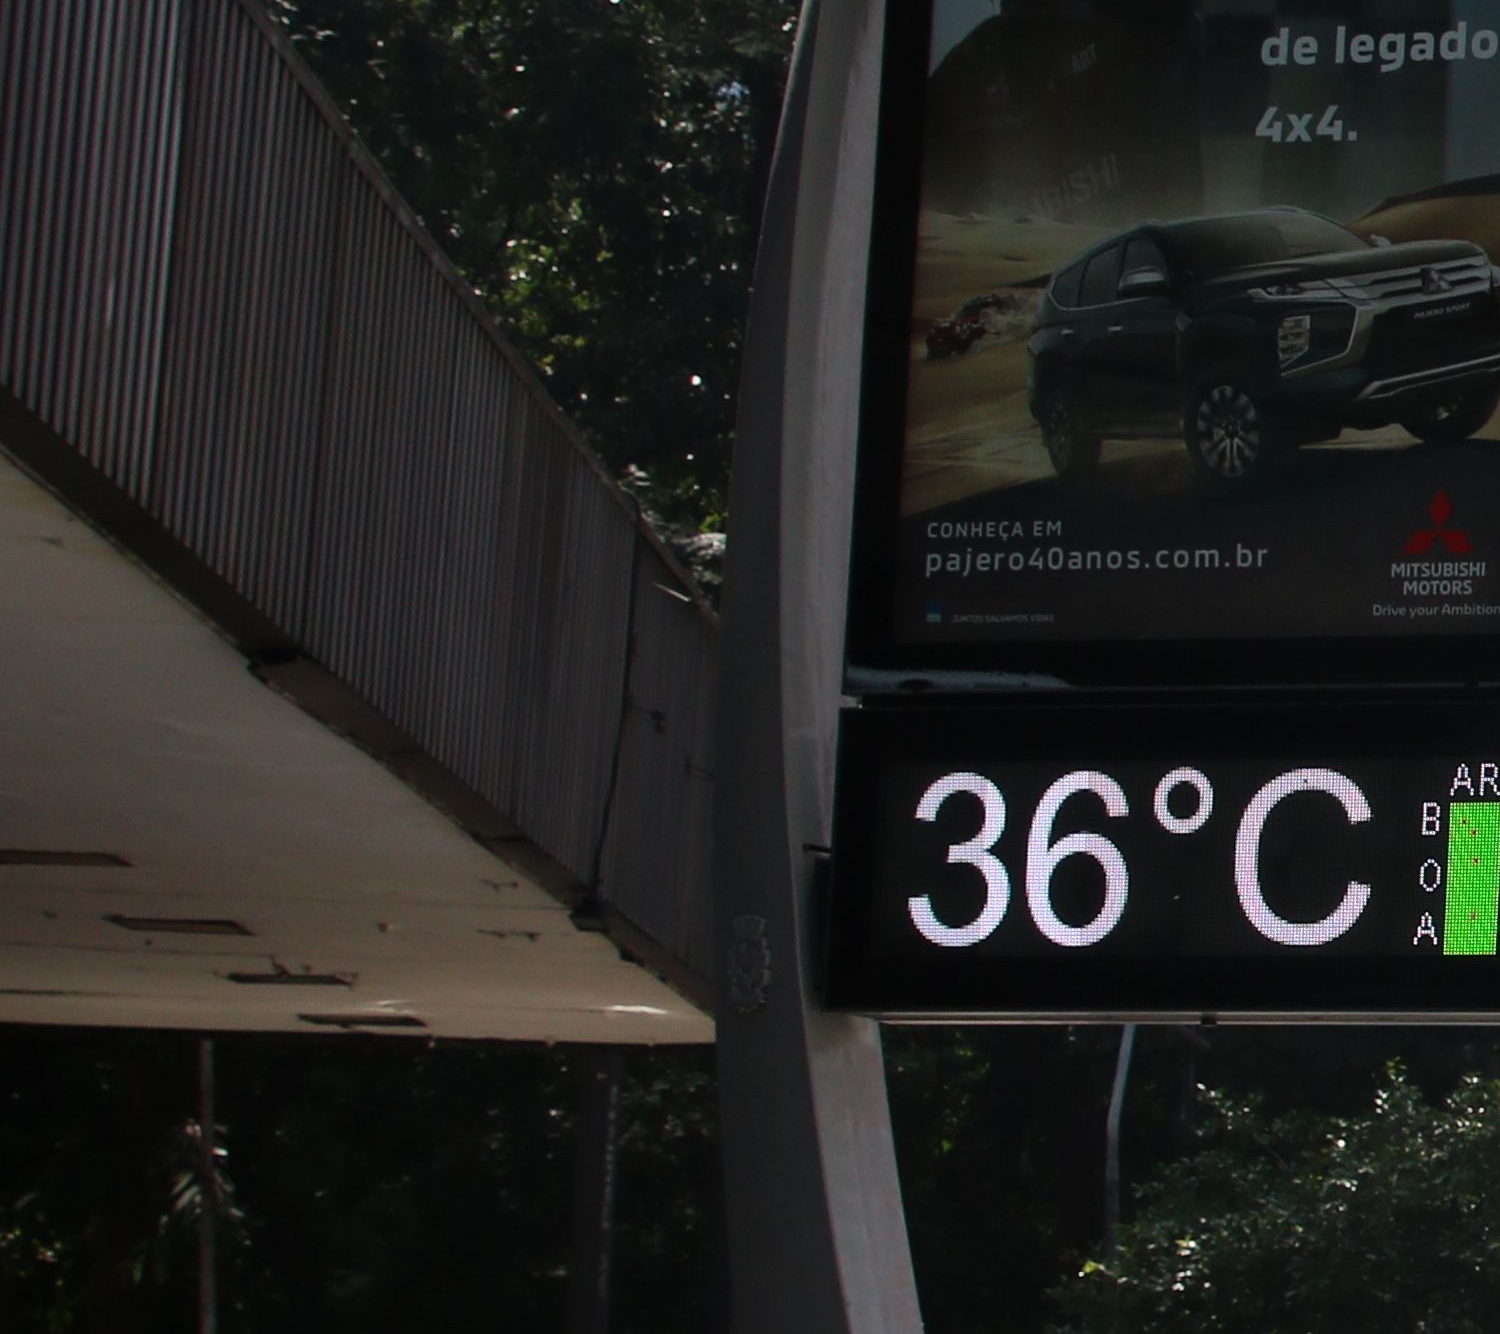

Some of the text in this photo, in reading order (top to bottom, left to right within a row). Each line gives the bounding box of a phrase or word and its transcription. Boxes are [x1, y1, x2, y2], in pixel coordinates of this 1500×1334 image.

[1260, 20, 1499, 73] de legado
[1255, 104, 1358, 143] 4x4.
[927, 521, 1061, 541] CONHEÇA EM
[925, 543, 1268, 578] pajero40anos.com.br
[1391, 561, 1486, 578] MITSUBISHI
[1403, 579, 1472, 595] MOTORS
[1372, 604, 1406, 617] Drive
[1410, 606, 1438, 619] your
[907, 766, 1372, 948] 36°C
